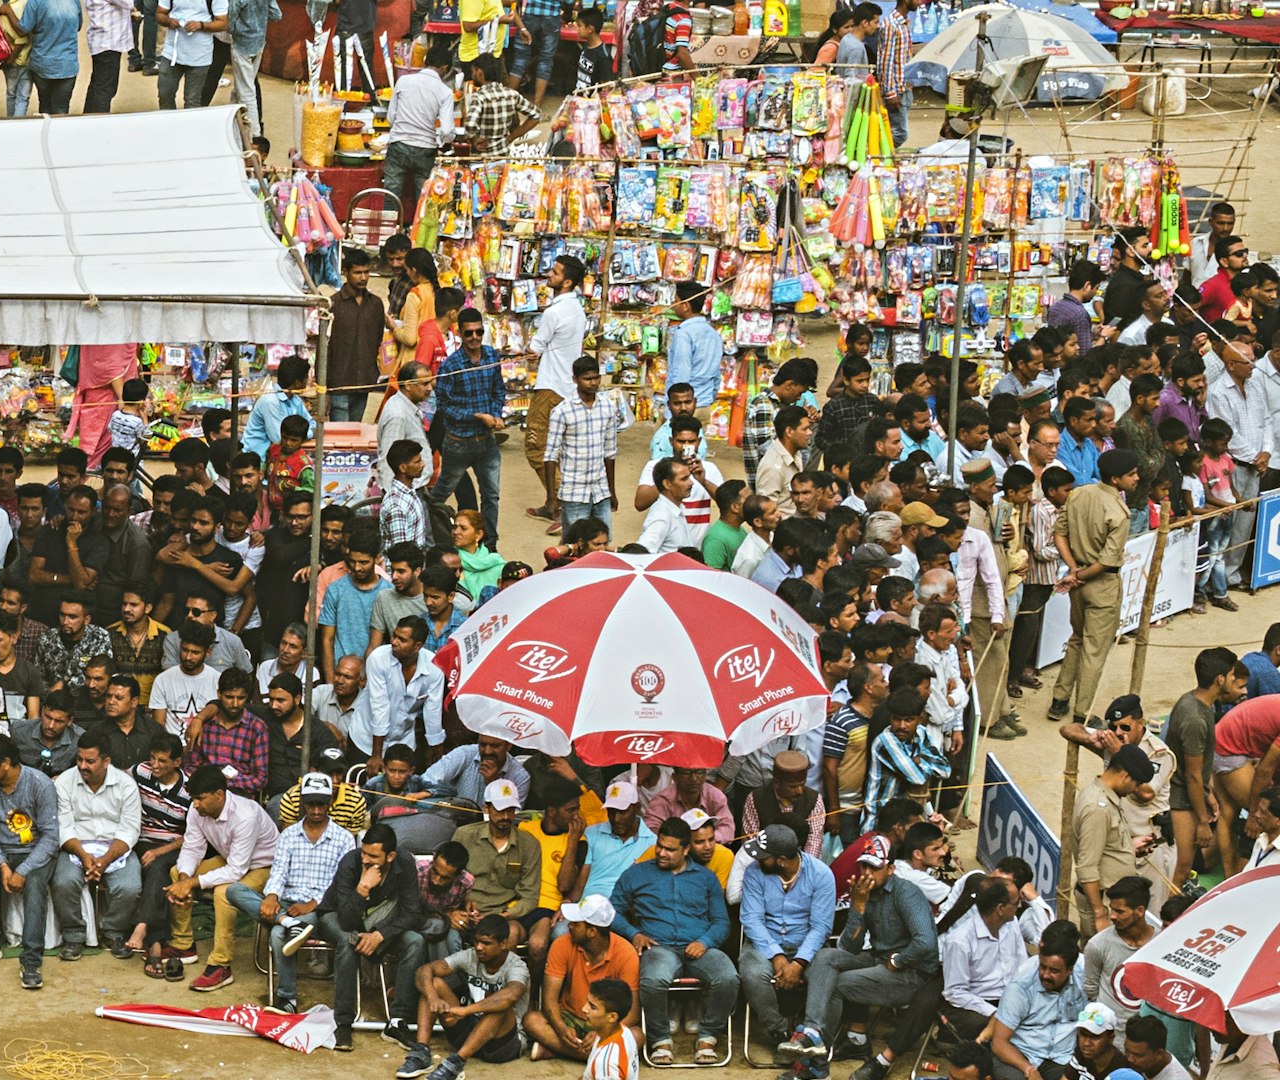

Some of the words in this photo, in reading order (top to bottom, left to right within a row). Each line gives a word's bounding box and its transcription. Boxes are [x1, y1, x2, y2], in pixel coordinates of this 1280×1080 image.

[519, 646, 568, 671] itel
[727, 646, 760, 679] itel
[495, 681, 523, 699] Smart
[524, 689, 554, 710] Phone
[738, 695, 768, 715] Smart
[765, 684, 794, 704] Phone
[506, 715, 535, 733] itel
[773, 710, 794, 733] itel
[628, 737, 663, 751] itel
[1214, 932, 1236, 945] OVER
[1161, 953, 1194, 970] ACROSS
[1192, 965, 1215, 979] INDIA
[1174, 948, 1221, 971] CUSTOMERS
[1167, 983, 1196, 1002] itel
[265, 1020, 290, 1039] hone
